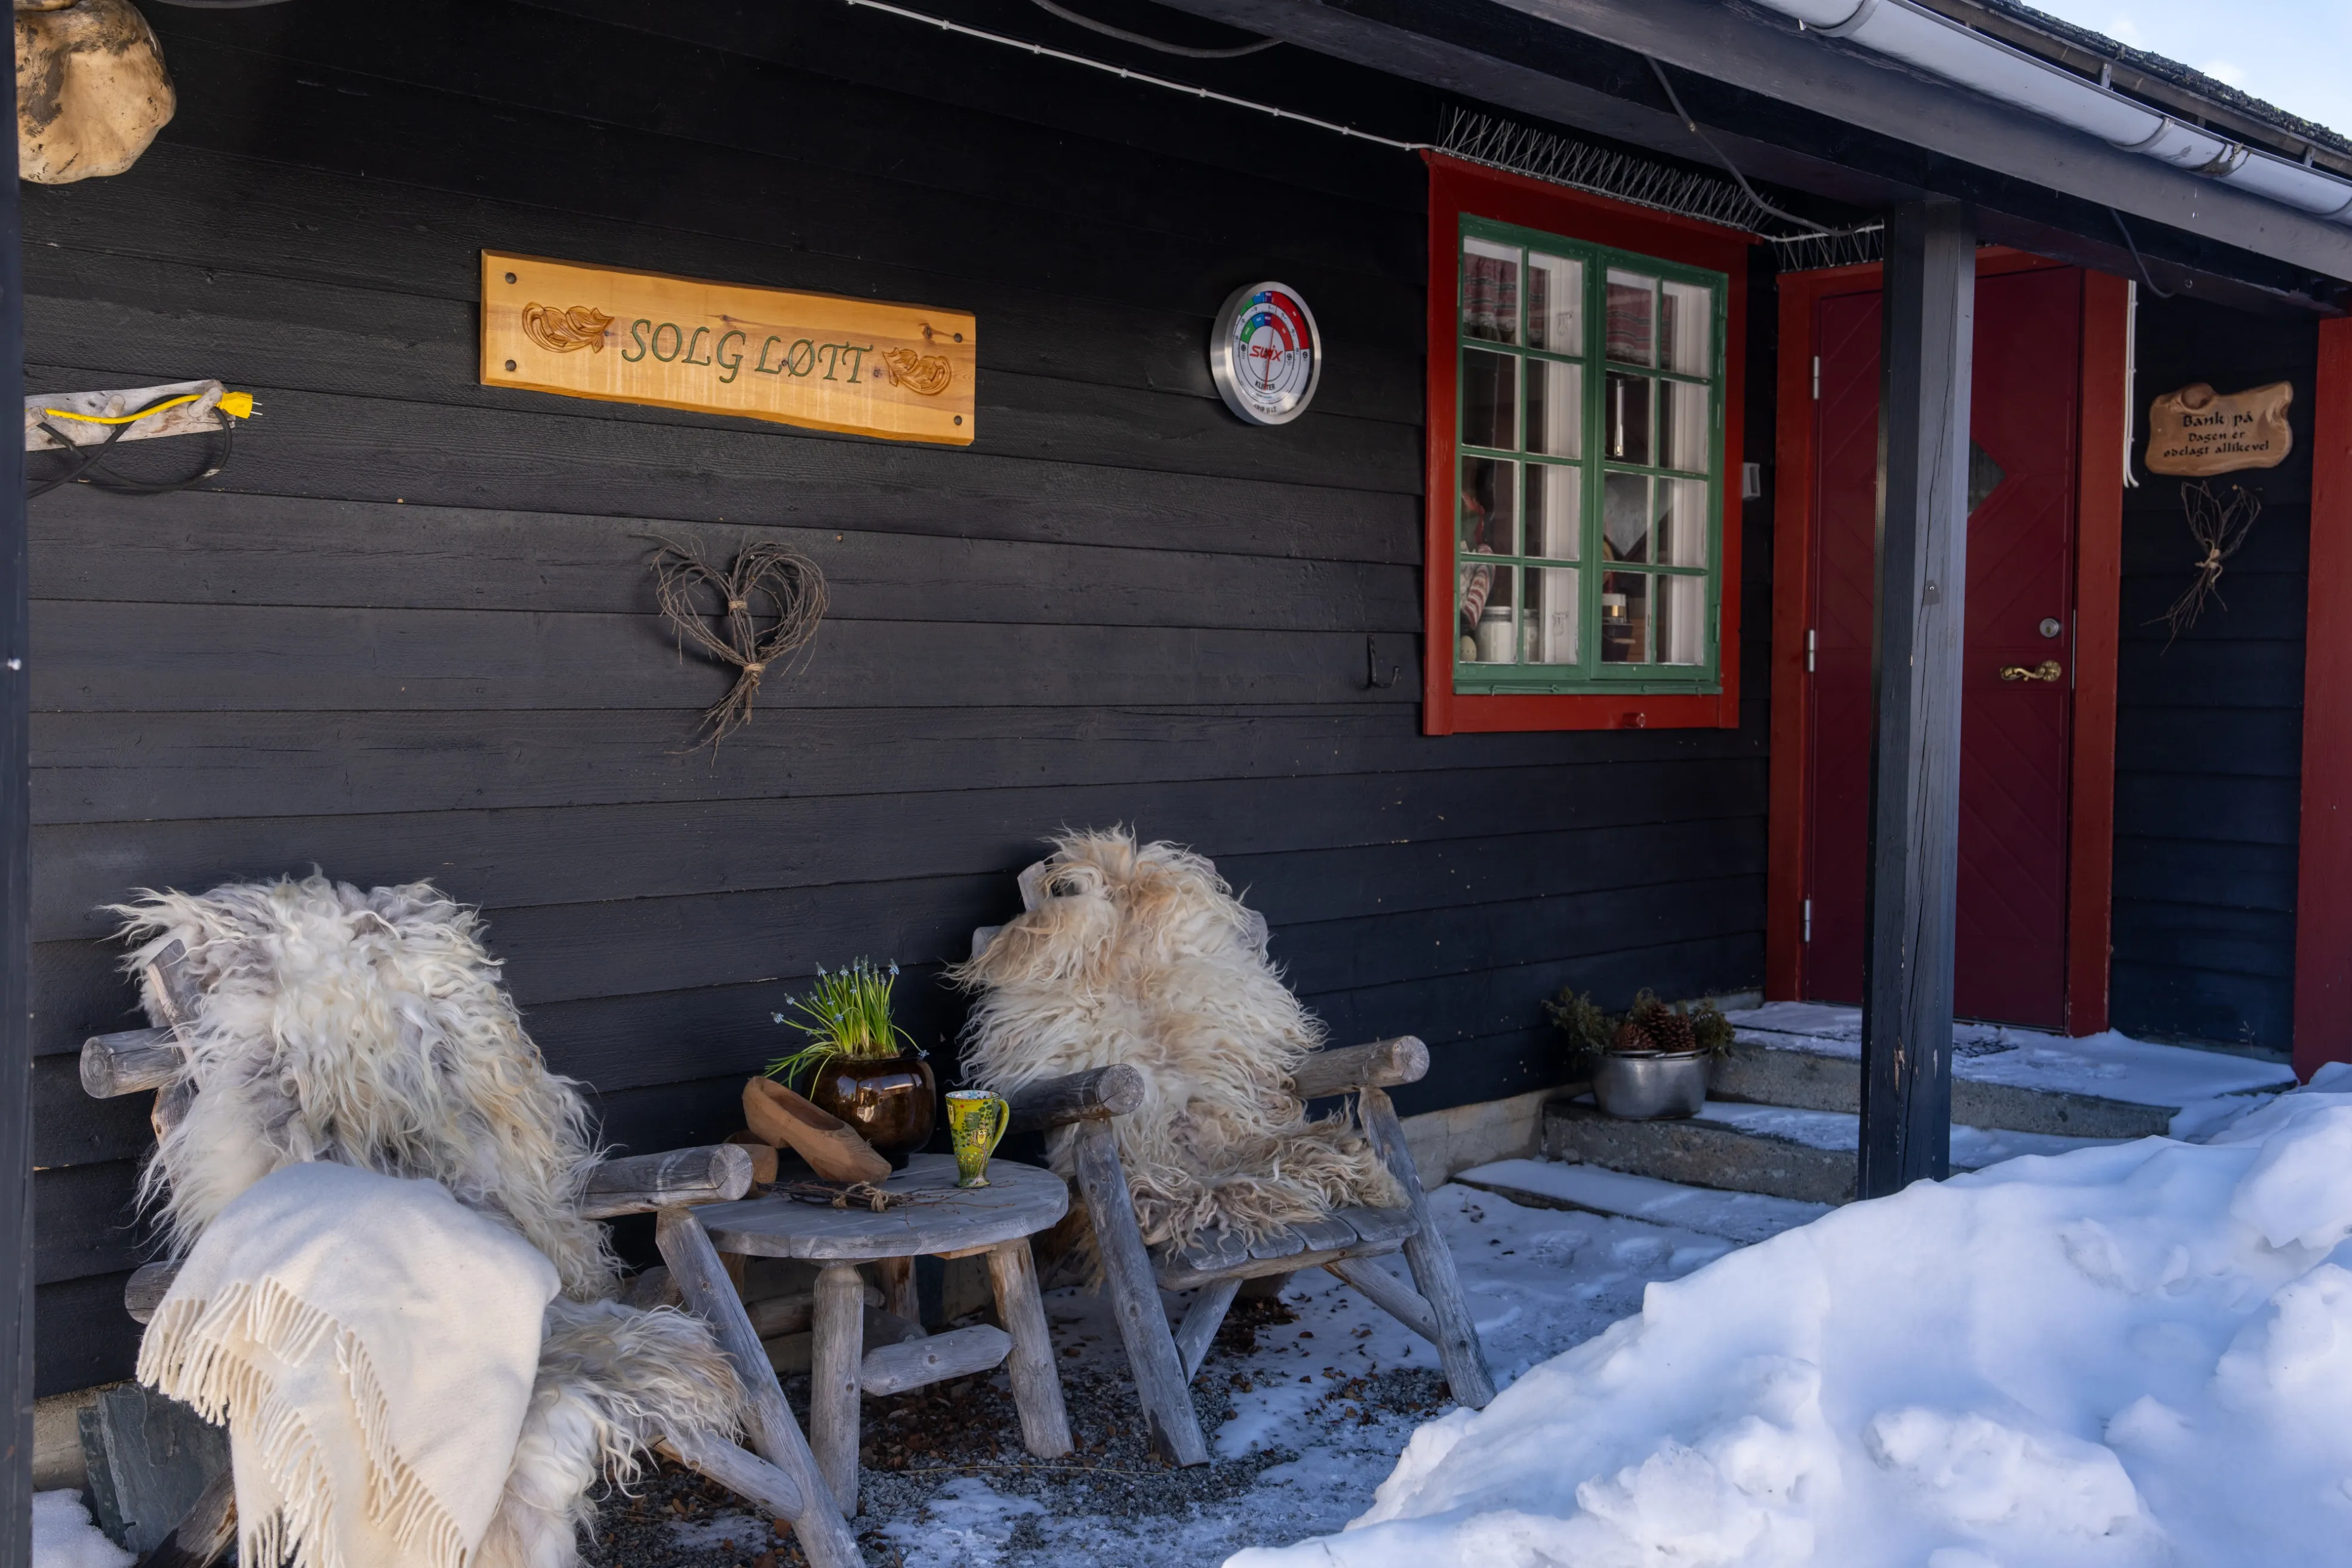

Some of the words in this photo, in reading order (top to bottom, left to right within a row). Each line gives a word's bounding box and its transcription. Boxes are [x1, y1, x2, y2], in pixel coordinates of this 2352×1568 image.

[2182, 411, 2224, 427] Bank
[2233, 411, 2254, 427] på
[2188, 432, 2227, 443] Dagen
[2232, 431, 2245, 439] er
